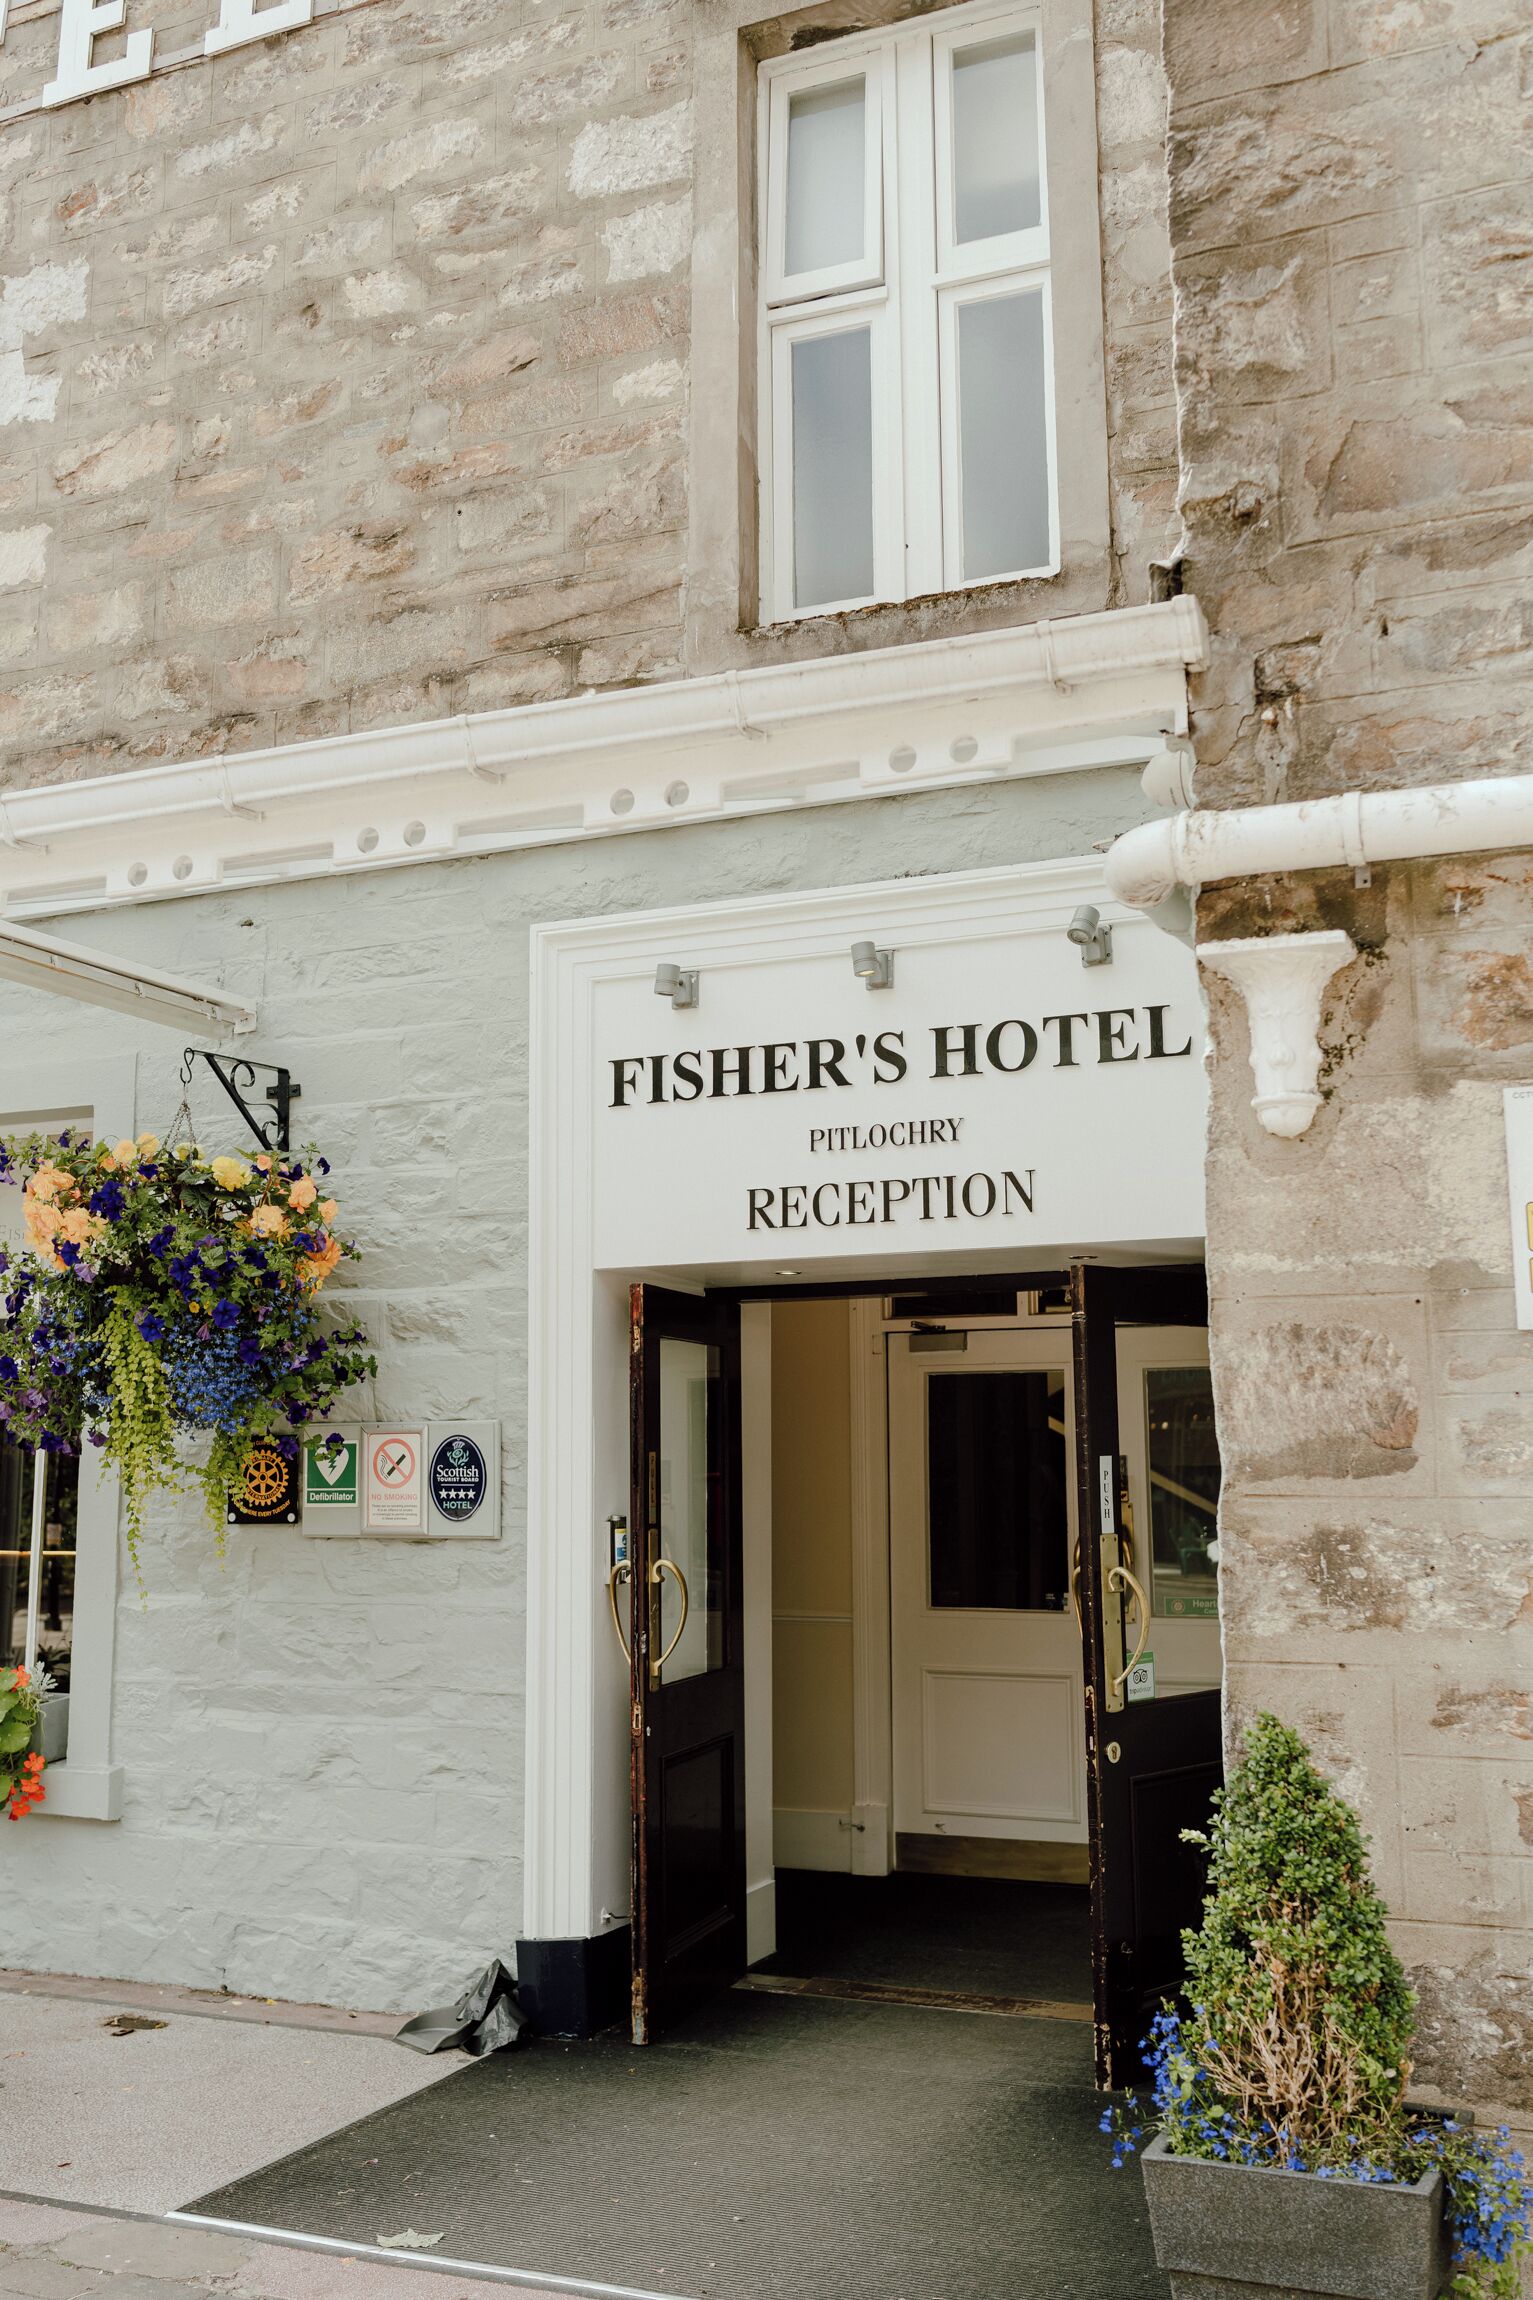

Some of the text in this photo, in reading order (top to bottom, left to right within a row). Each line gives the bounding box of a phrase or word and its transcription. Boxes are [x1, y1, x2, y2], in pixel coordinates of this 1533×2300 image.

[608, 1004, 1192, 1108] FISHER'S HOTEL
[809, 1117, 964, 1152] PITLOCHRY
[746, 1169, 1037, 1230] RECEPTION
[436, 1464, 479, 1478] Scottish
[309, 1492, 354, 1501] Defibrillator
[442, 1501, 473, 1509] HOTEL
[1103, 1470, 1111, 1519] PUSH
